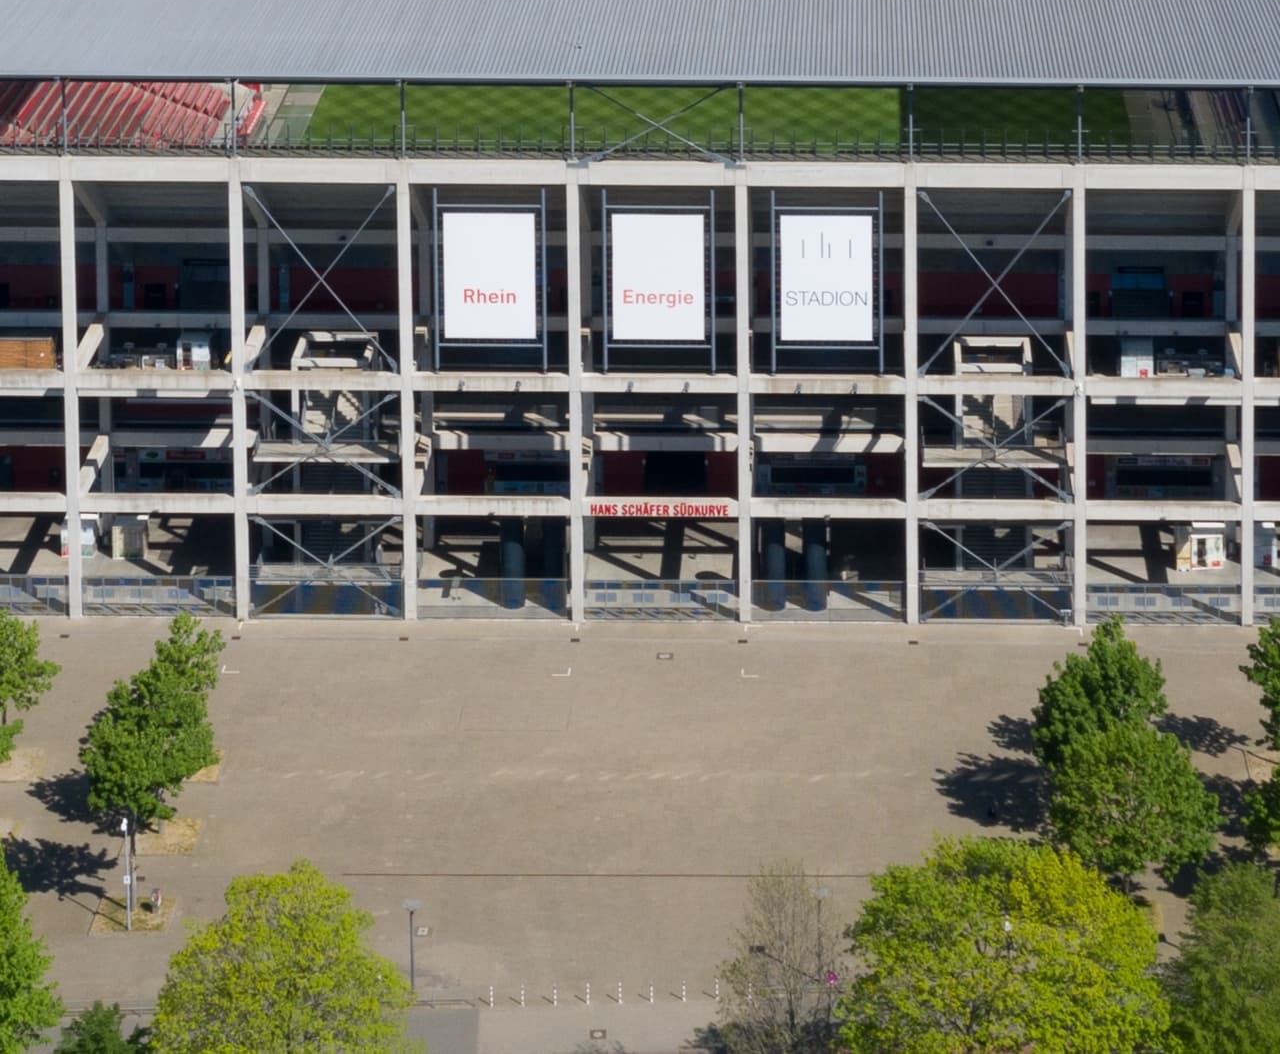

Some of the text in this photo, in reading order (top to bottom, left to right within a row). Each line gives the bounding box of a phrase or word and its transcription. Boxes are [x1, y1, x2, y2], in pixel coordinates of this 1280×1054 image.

[462, 288, 869, 308] Rhein Energie STADION
[590, 502, 728, 516] HANS SCHÄFER SÜDKURVE
